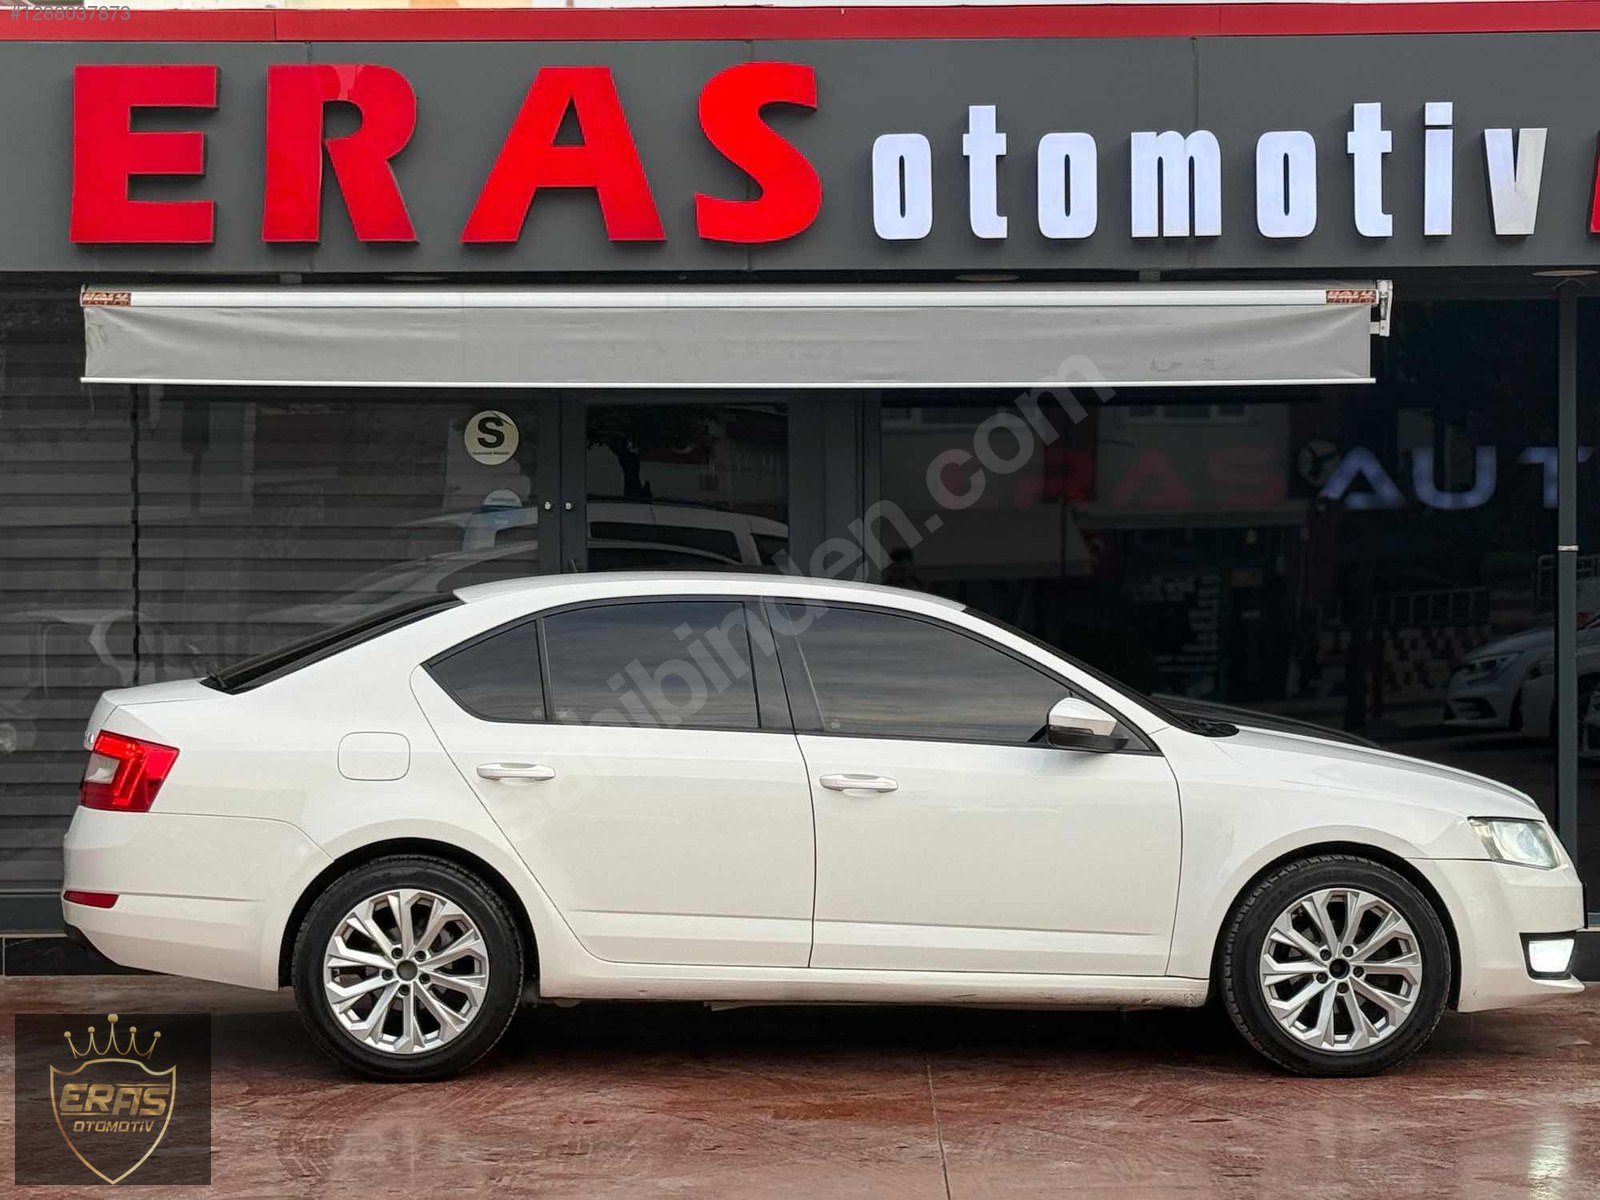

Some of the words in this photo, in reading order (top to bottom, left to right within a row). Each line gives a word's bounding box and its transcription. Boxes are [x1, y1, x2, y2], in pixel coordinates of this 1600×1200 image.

[70, 62, 823, 244] ERAS
[872, 102, 1548, 240] otomotiv
[477, 416, 505, 449] S
